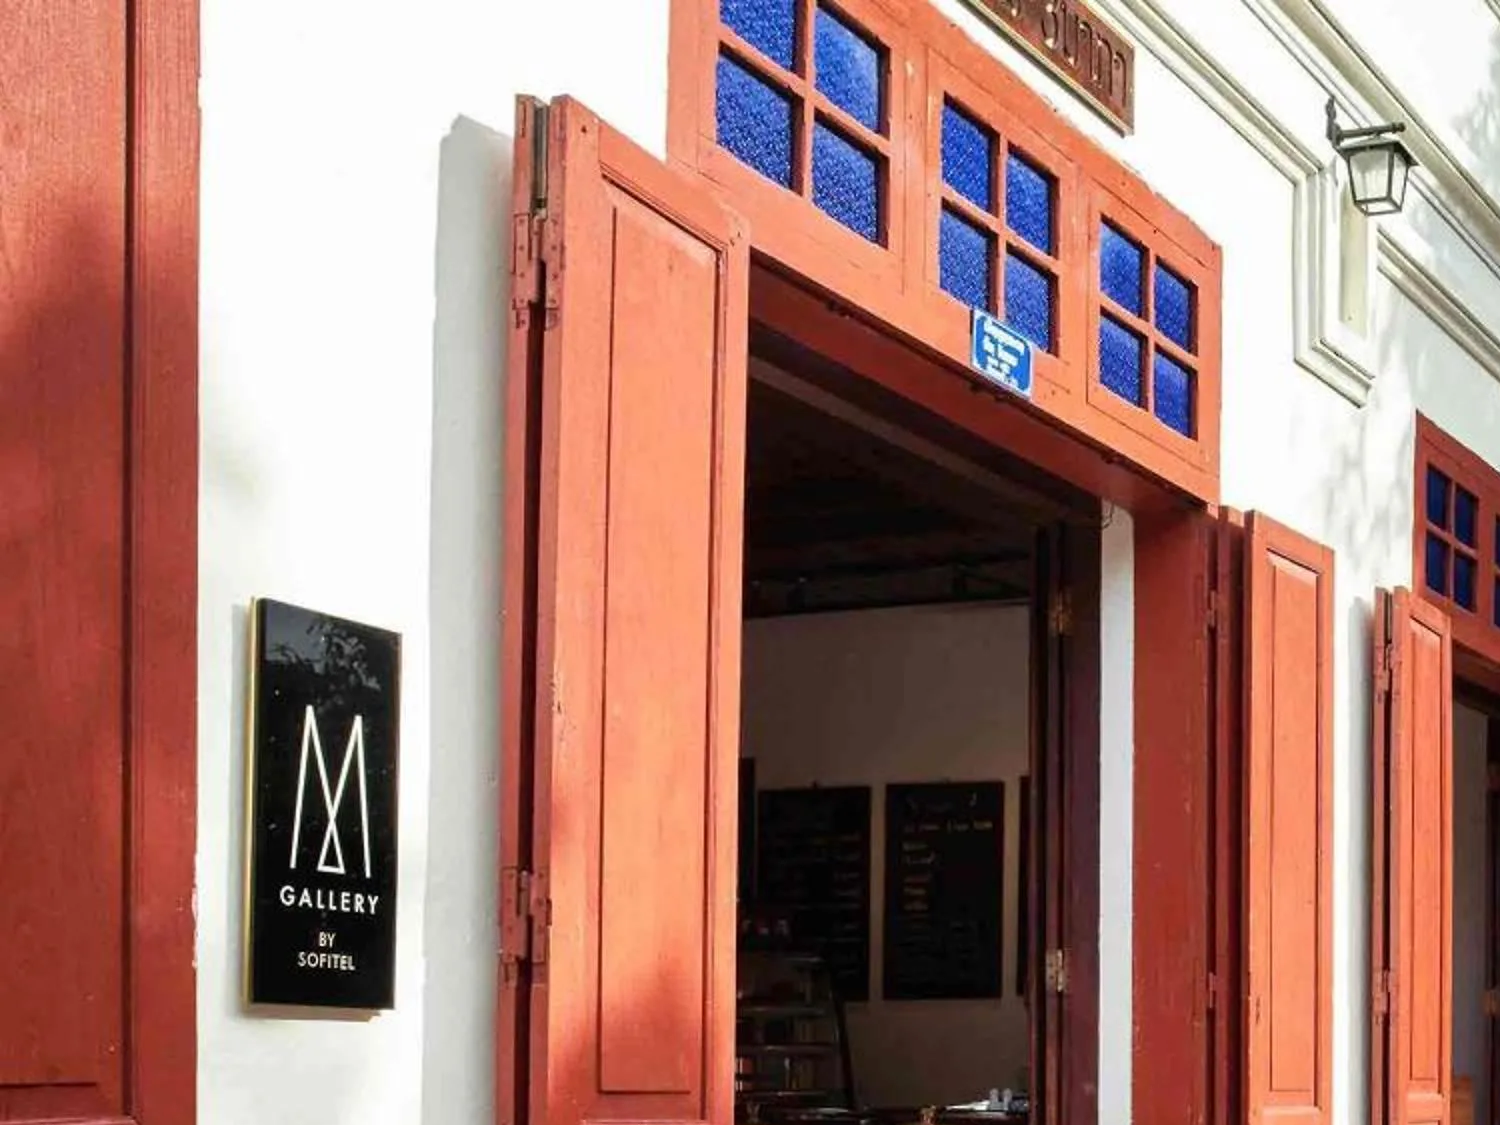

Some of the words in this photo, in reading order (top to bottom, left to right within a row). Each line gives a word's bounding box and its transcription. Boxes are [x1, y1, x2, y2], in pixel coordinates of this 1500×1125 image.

[279, 885, 380, 914] GALLERY
[318, 931, 336, 949] BY
[297, 951, 356, 971] SOFITEL
